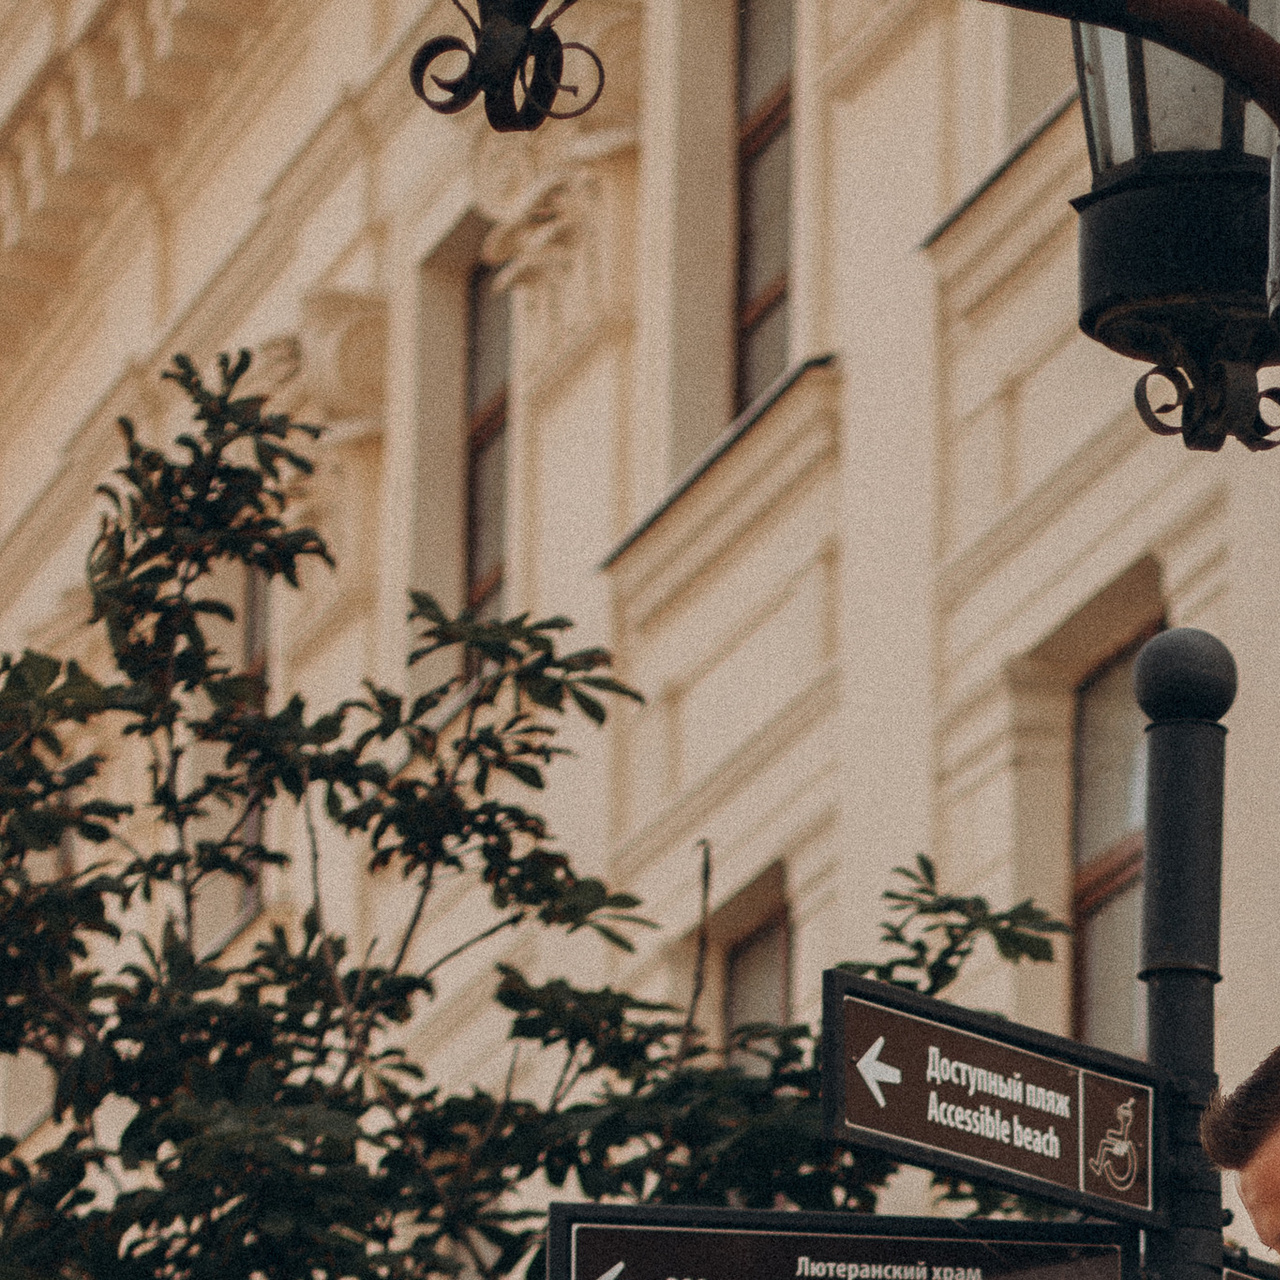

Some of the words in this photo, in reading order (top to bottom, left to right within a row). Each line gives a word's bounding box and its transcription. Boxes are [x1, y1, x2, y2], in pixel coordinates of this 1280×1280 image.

[926, 1045, 1024, 1104] Доступный
[1025, 1083, 1071, 1118] пляж
[927, 1090, 1011, 1144] Accessible
[1013, 1114, 1061, 1159] beach
